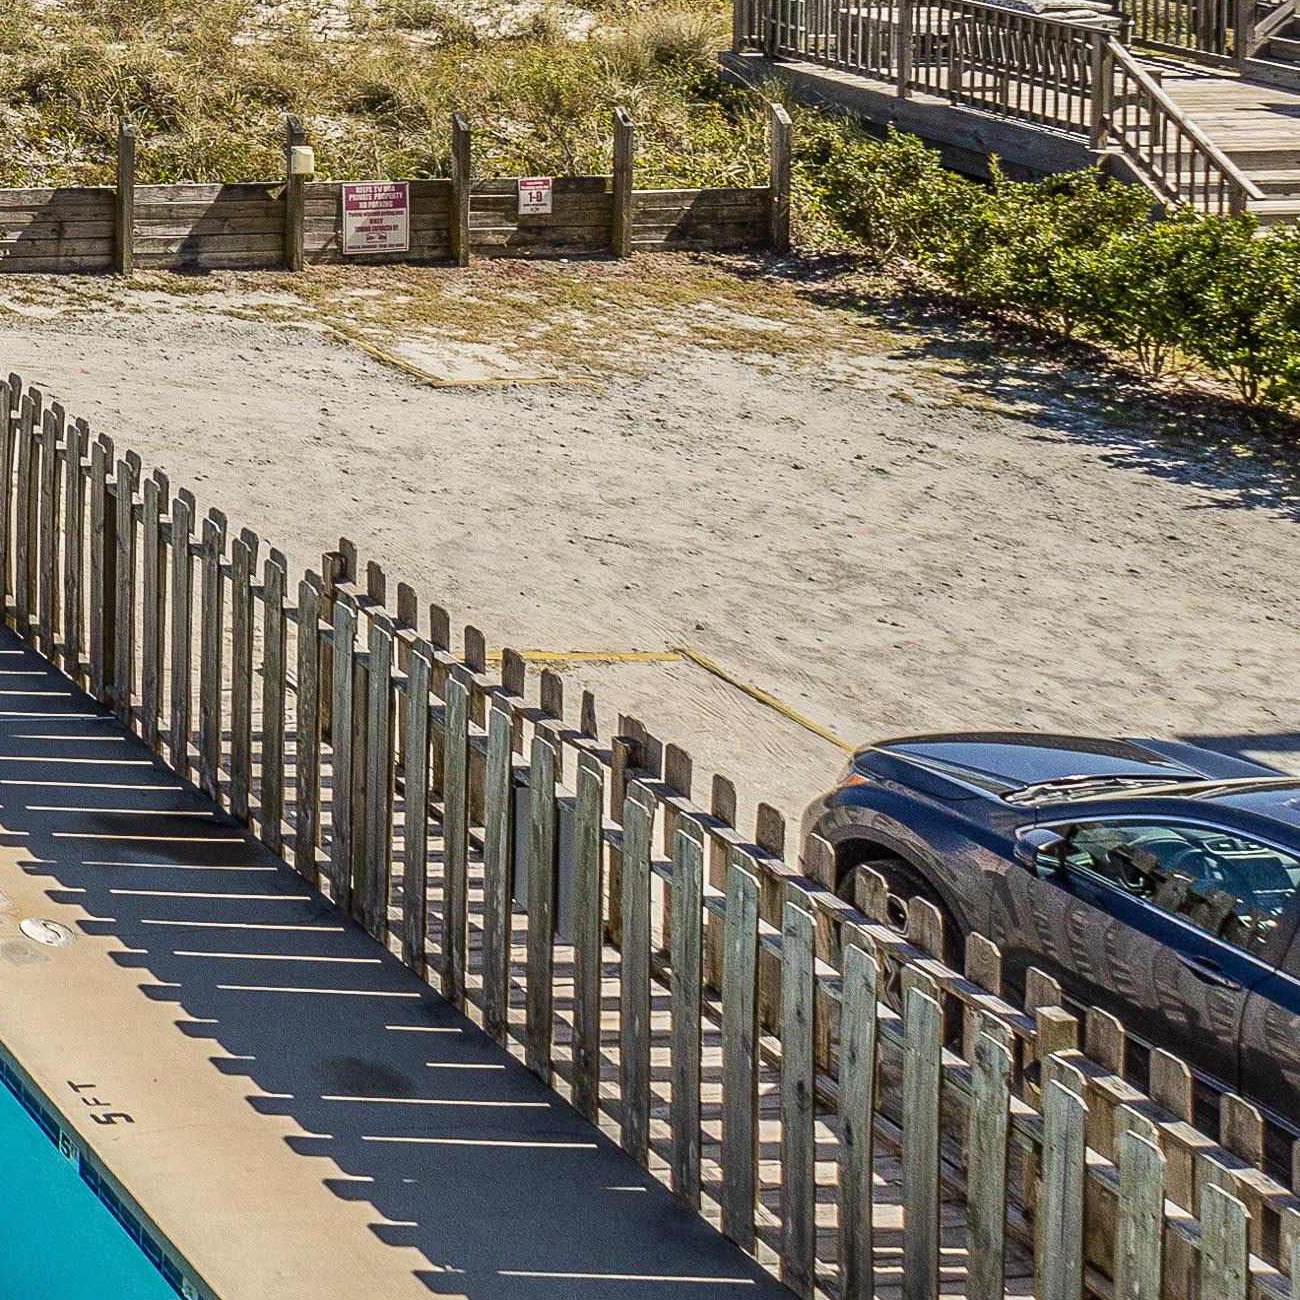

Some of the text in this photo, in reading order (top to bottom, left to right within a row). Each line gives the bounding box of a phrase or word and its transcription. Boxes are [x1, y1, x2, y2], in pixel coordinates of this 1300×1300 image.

[348, 192, 403, 201] PRIVATE PROPERTY
[368, 200, 394, 208] PARKING
